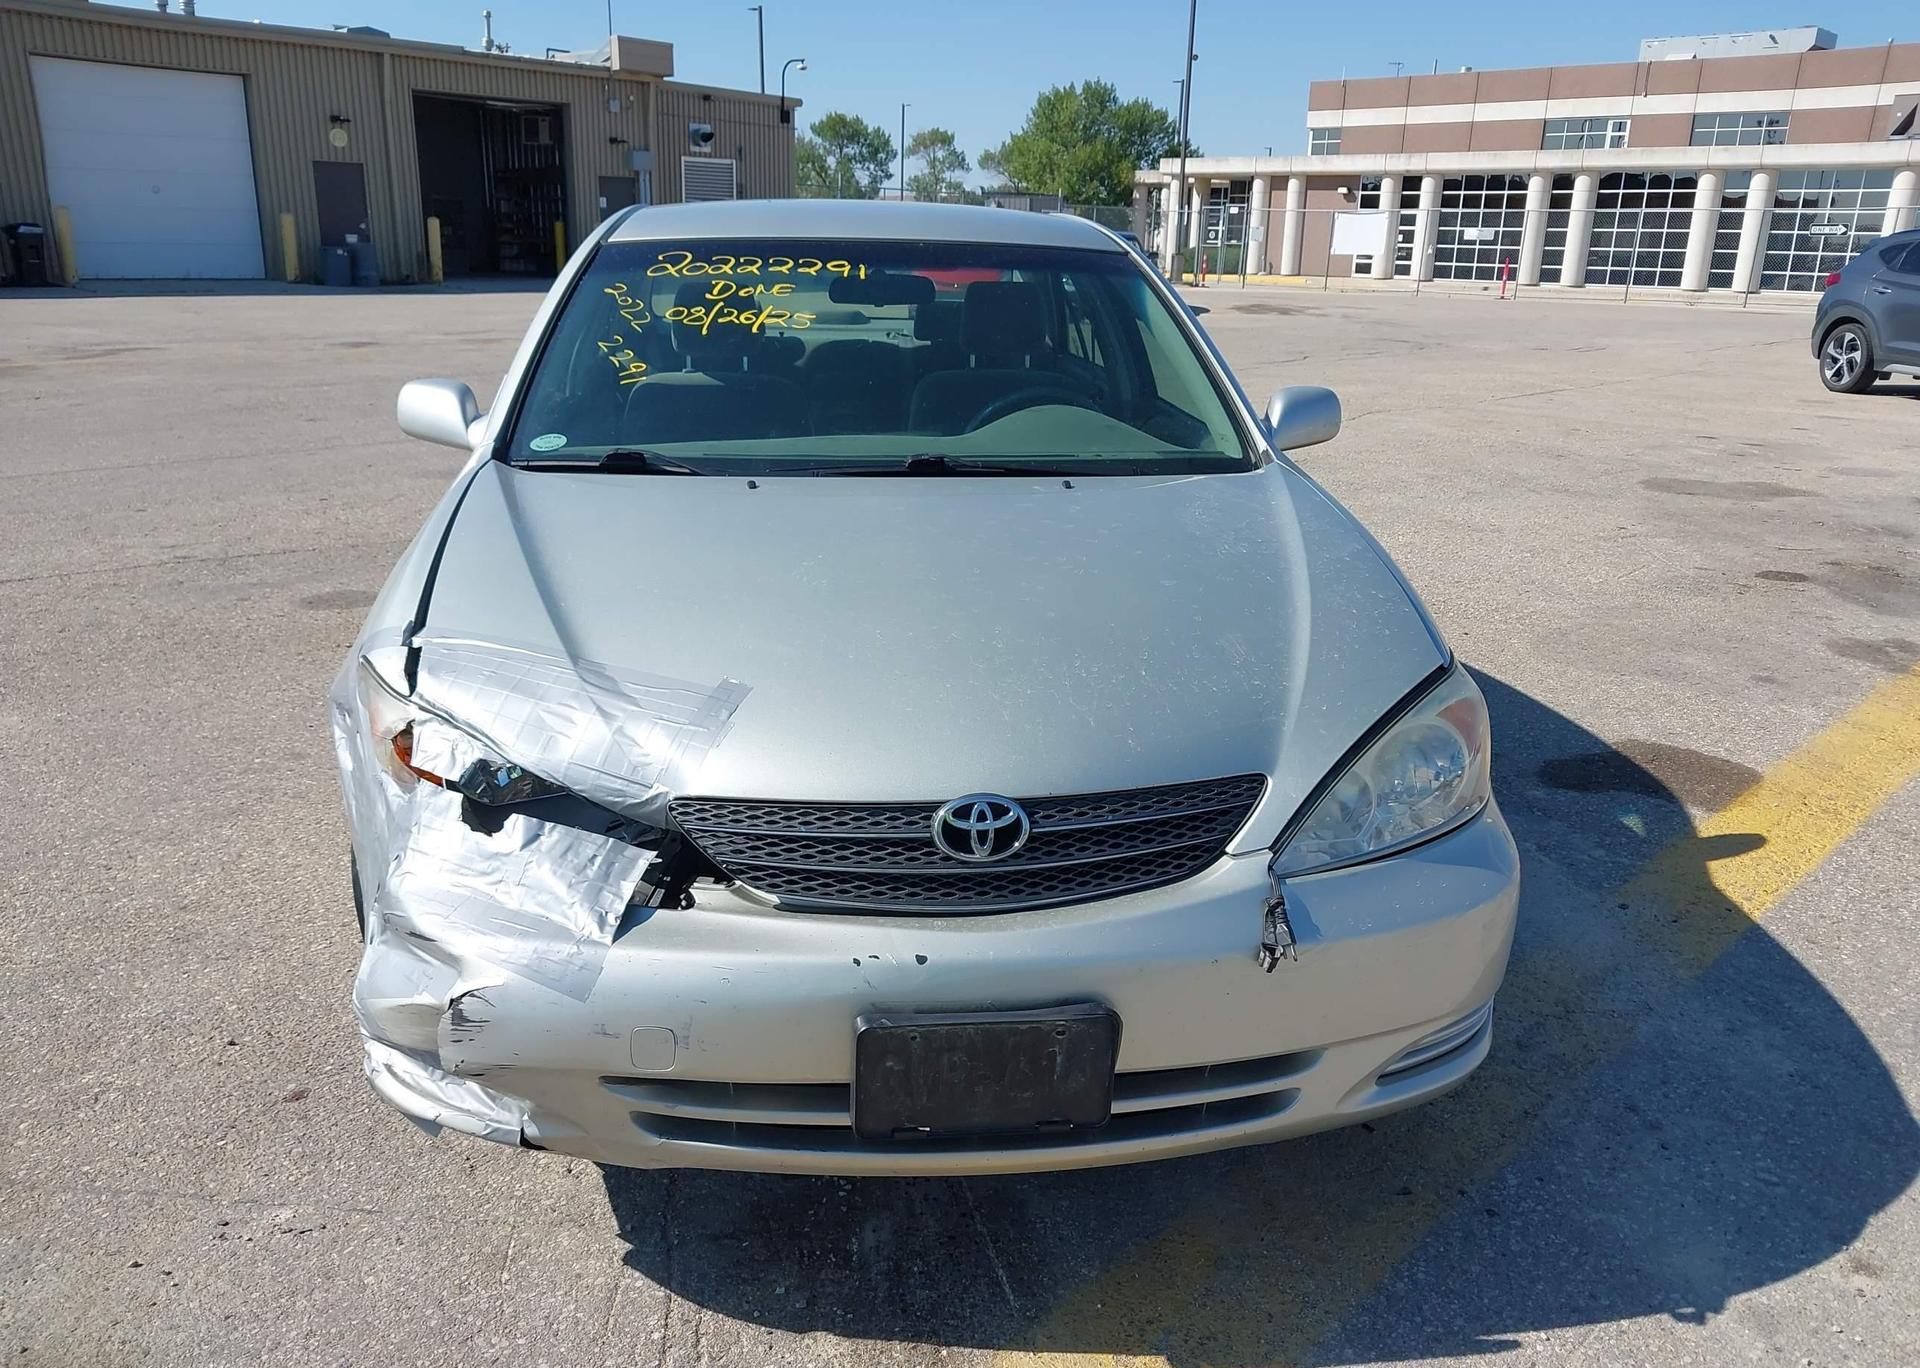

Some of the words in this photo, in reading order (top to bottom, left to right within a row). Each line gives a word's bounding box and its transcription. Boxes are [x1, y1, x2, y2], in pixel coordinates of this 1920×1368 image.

[647, 251, 867, 280] 20222291
[603, 283, 651, 333] 2022
[665, 302, 816, 336] 08/26/25
[597, 335, 647, 385] 2291
